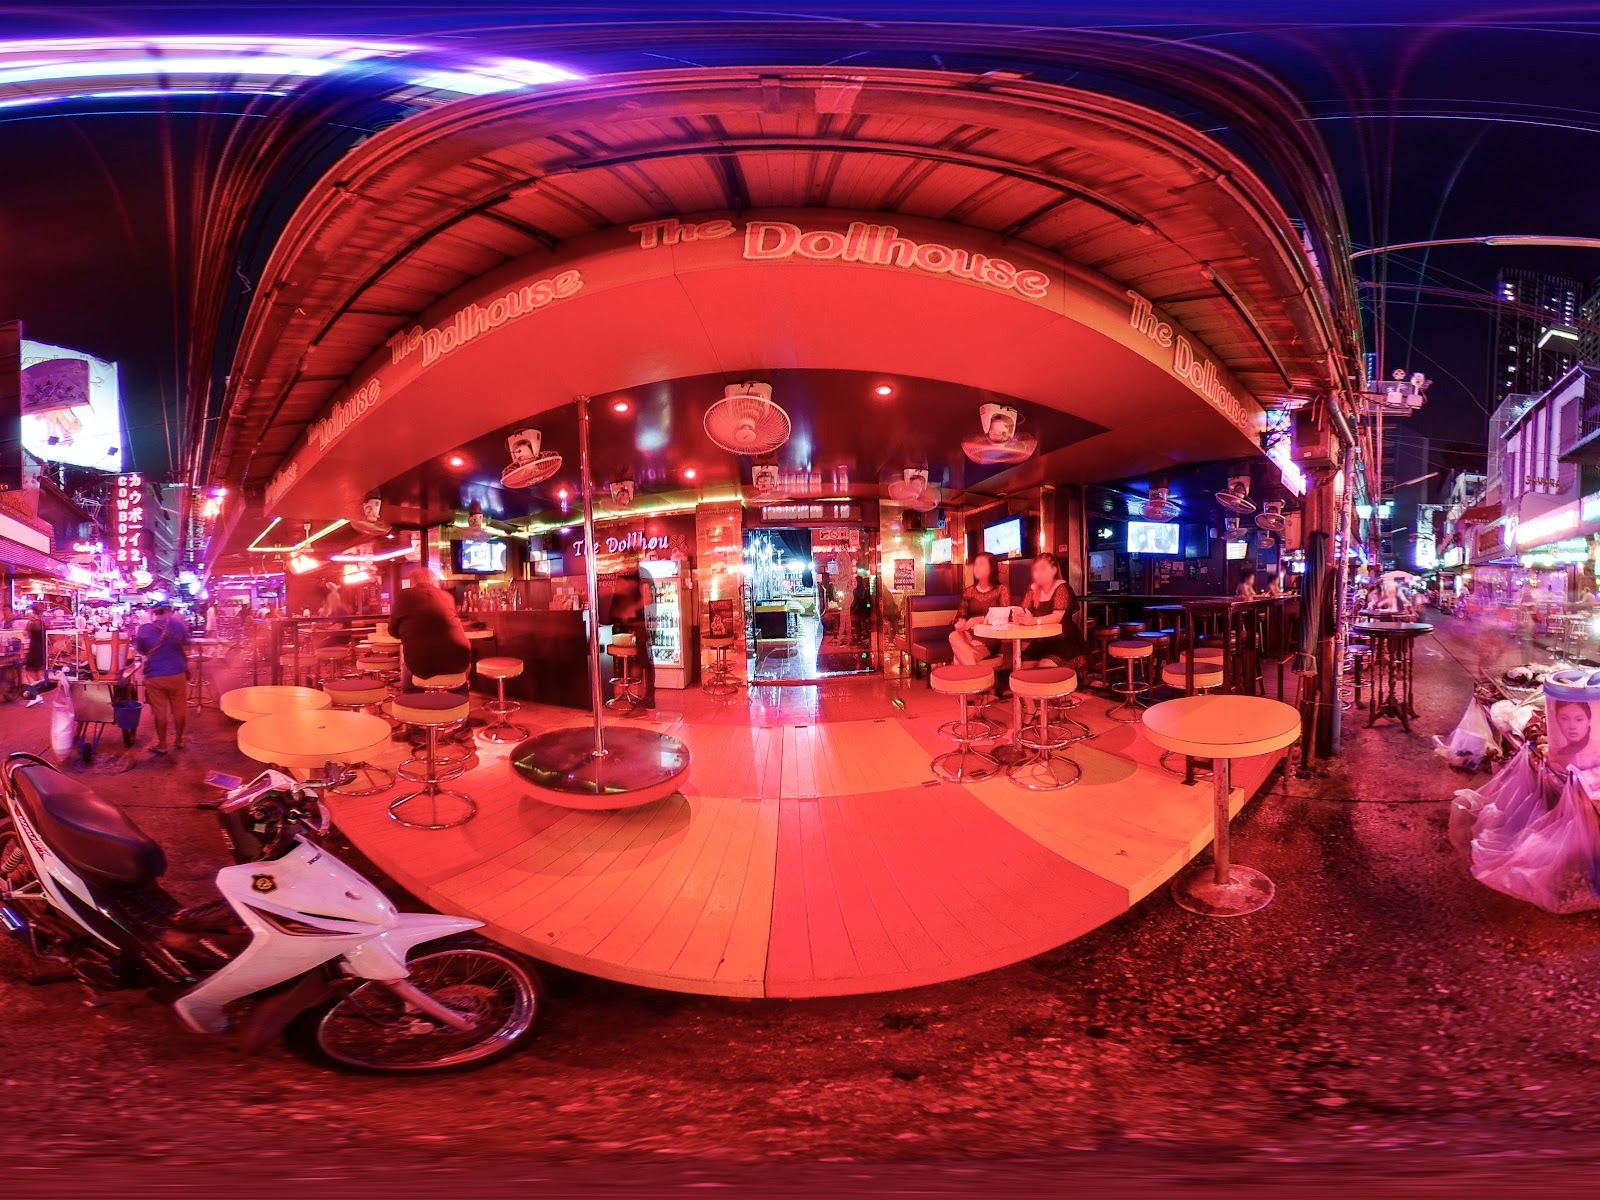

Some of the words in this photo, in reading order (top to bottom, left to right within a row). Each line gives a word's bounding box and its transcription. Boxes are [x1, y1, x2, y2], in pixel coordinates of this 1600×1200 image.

[629, 218, 737, 249] The
[742, 221, 1051, 299] Dollhouse
[386, 324, 423, 365] The
[421, 269, 585, 368] Dollhouse
[1126, 289, 1173, 349] The
[1172, 333, 1249, 430] Dollhouse
[572, 538, 600, 557] Te
[606, 529, 688, 554] Dollhouse
